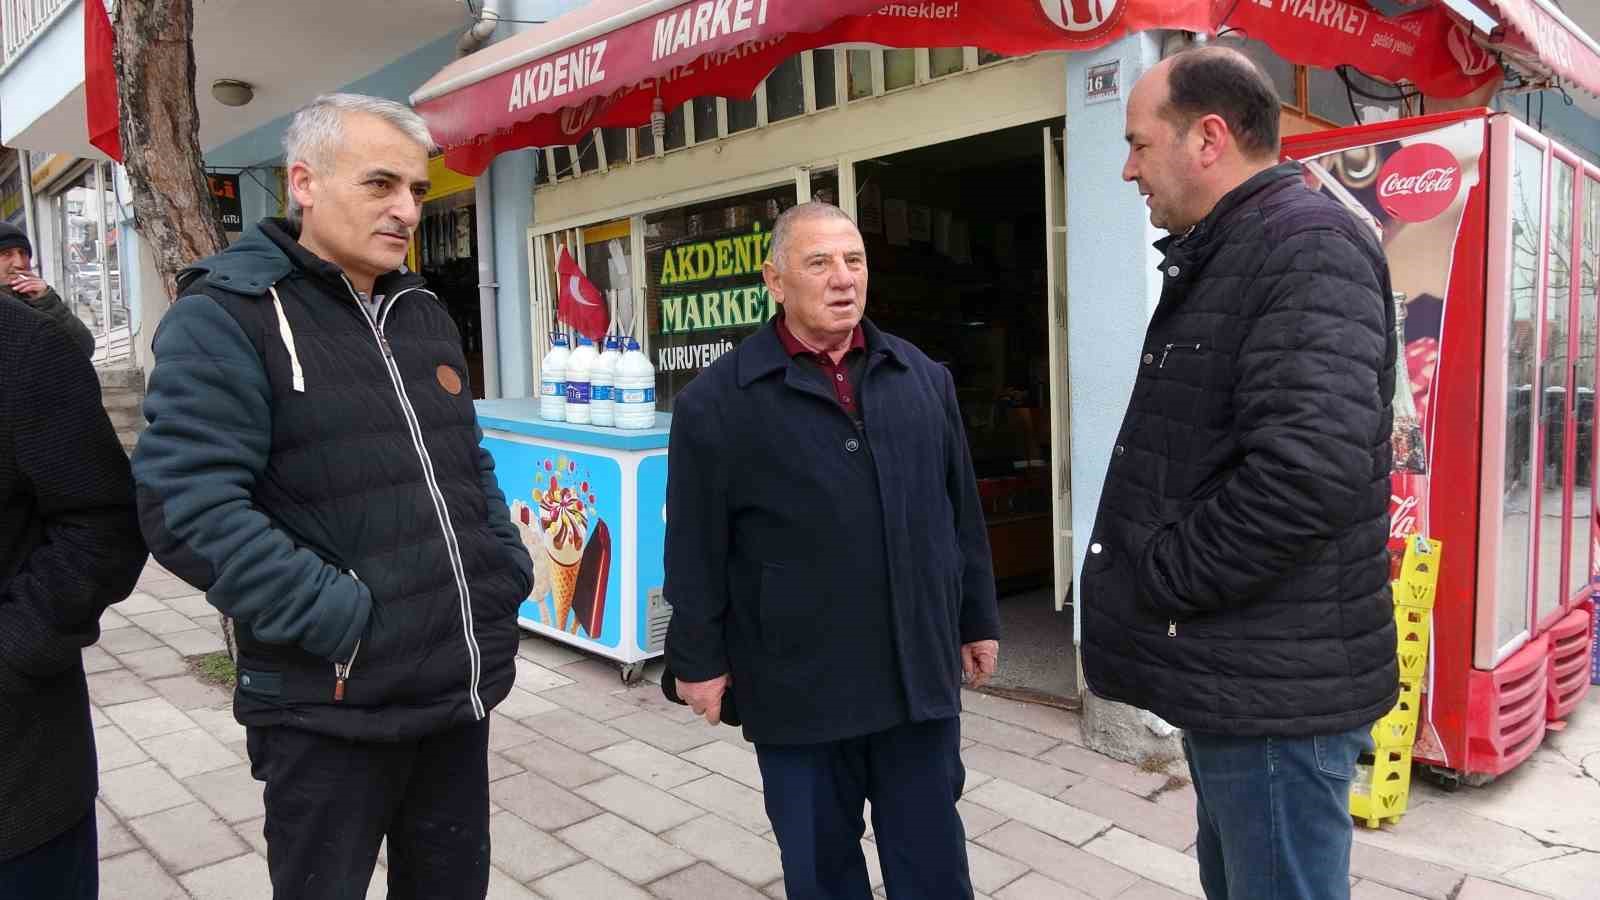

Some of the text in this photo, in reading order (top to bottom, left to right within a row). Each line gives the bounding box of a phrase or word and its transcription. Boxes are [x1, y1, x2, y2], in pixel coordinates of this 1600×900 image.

[1089, 75, 1104, 92] 16
[1380, 167, 1457, 197] Coca-Cola
[661, 284, 777, 335] MARKET
